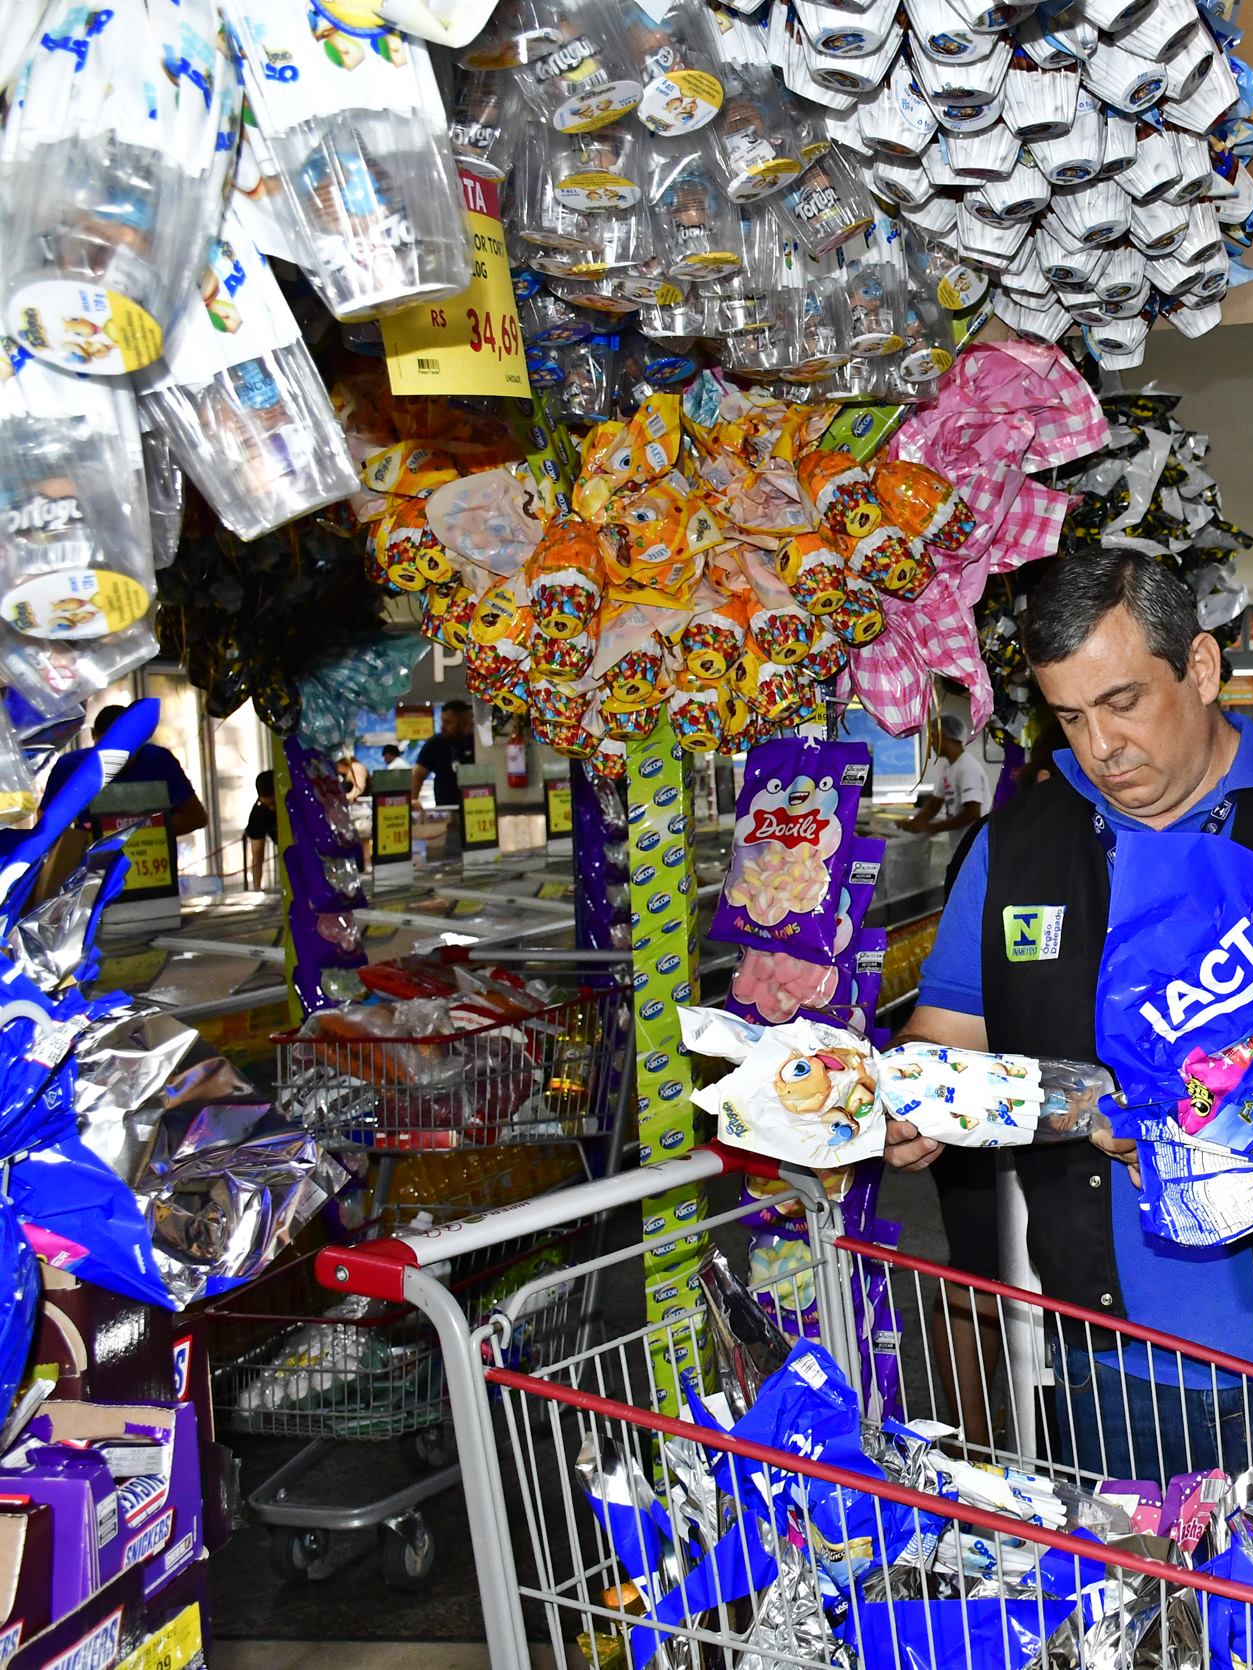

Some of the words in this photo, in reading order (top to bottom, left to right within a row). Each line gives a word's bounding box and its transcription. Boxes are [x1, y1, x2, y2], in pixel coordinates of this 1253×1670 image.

[466, 307, 519, 362] 34,69
[639, 759, 664, 776] ARCOR
[653, 787, 678, 802] ARCOR
[755, 813, 818, 839] Docile
[637, 832, 661, 849] ARCOR
[135, 857, 168, 878] 15,99
[633, 866, 657, 883] ARCOR
[648, 894, 672, 911] ARCOR
[1040, 923, 1052, 955] Órgão
[1050, 909, 1063, 954] Delegado
[657, 957, 681, 973] ARCOR
[641, 1002, 665, 1018] ARCOR
[645, 1055, 670, 1070] ARCOR
[659, 1083, 684, 1098] ARCOR
[661, 1131, 685, 1147] ARCOR
[643, 1219, 666, 1233] ARCOR
[653, 1287, 679, 1301] ARCOR
[125, 1515, 172, 1568] SNICKERS
